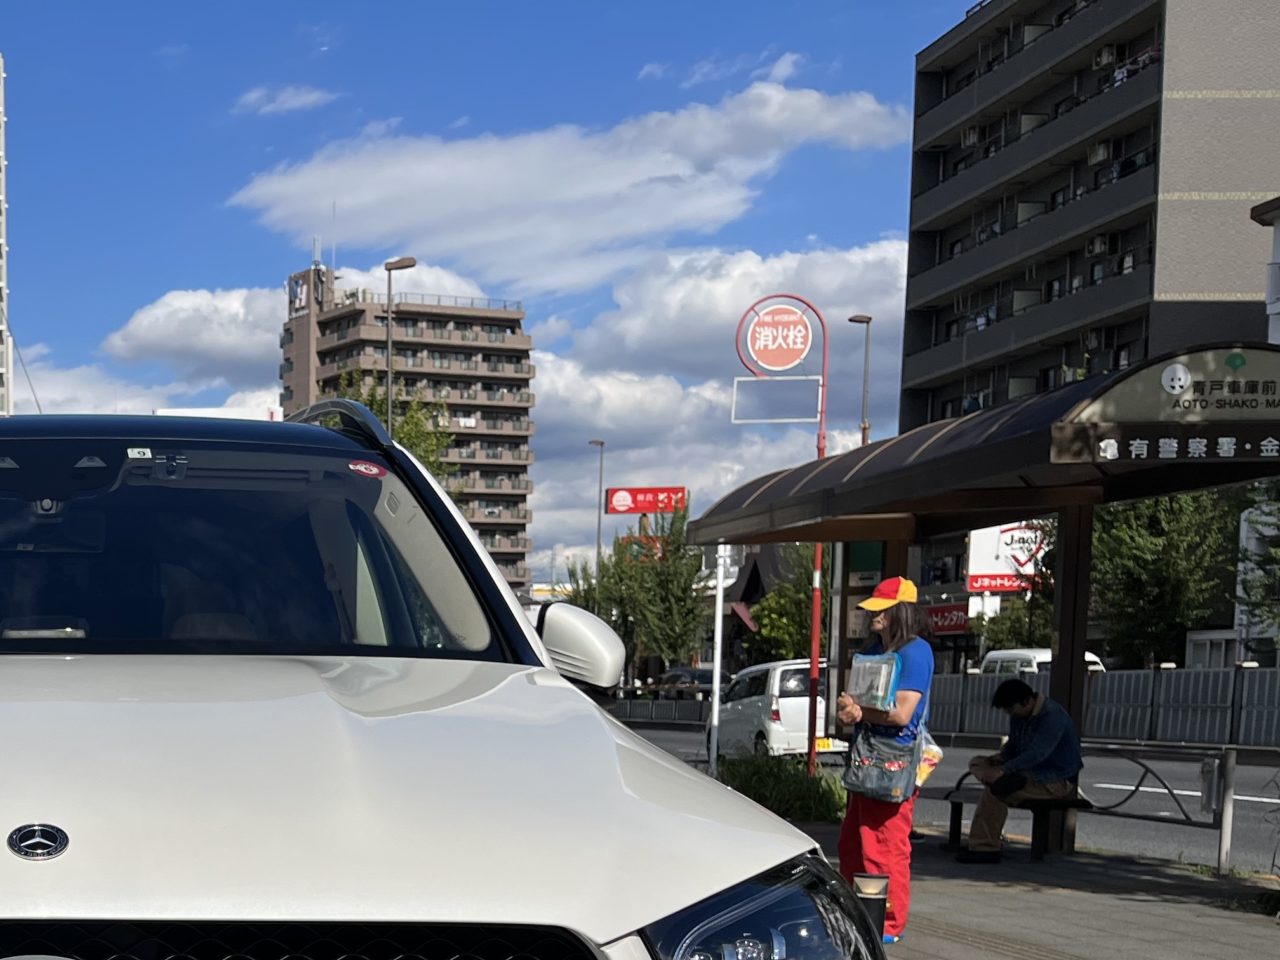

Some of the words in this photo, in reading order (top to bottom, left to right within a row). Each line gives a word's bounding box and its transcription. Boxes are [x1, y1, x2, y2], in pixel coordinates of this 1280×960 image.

[754, 324, 806, 350] 消火栓
[1192, 380, 1277, 396] 青戸車庫前
